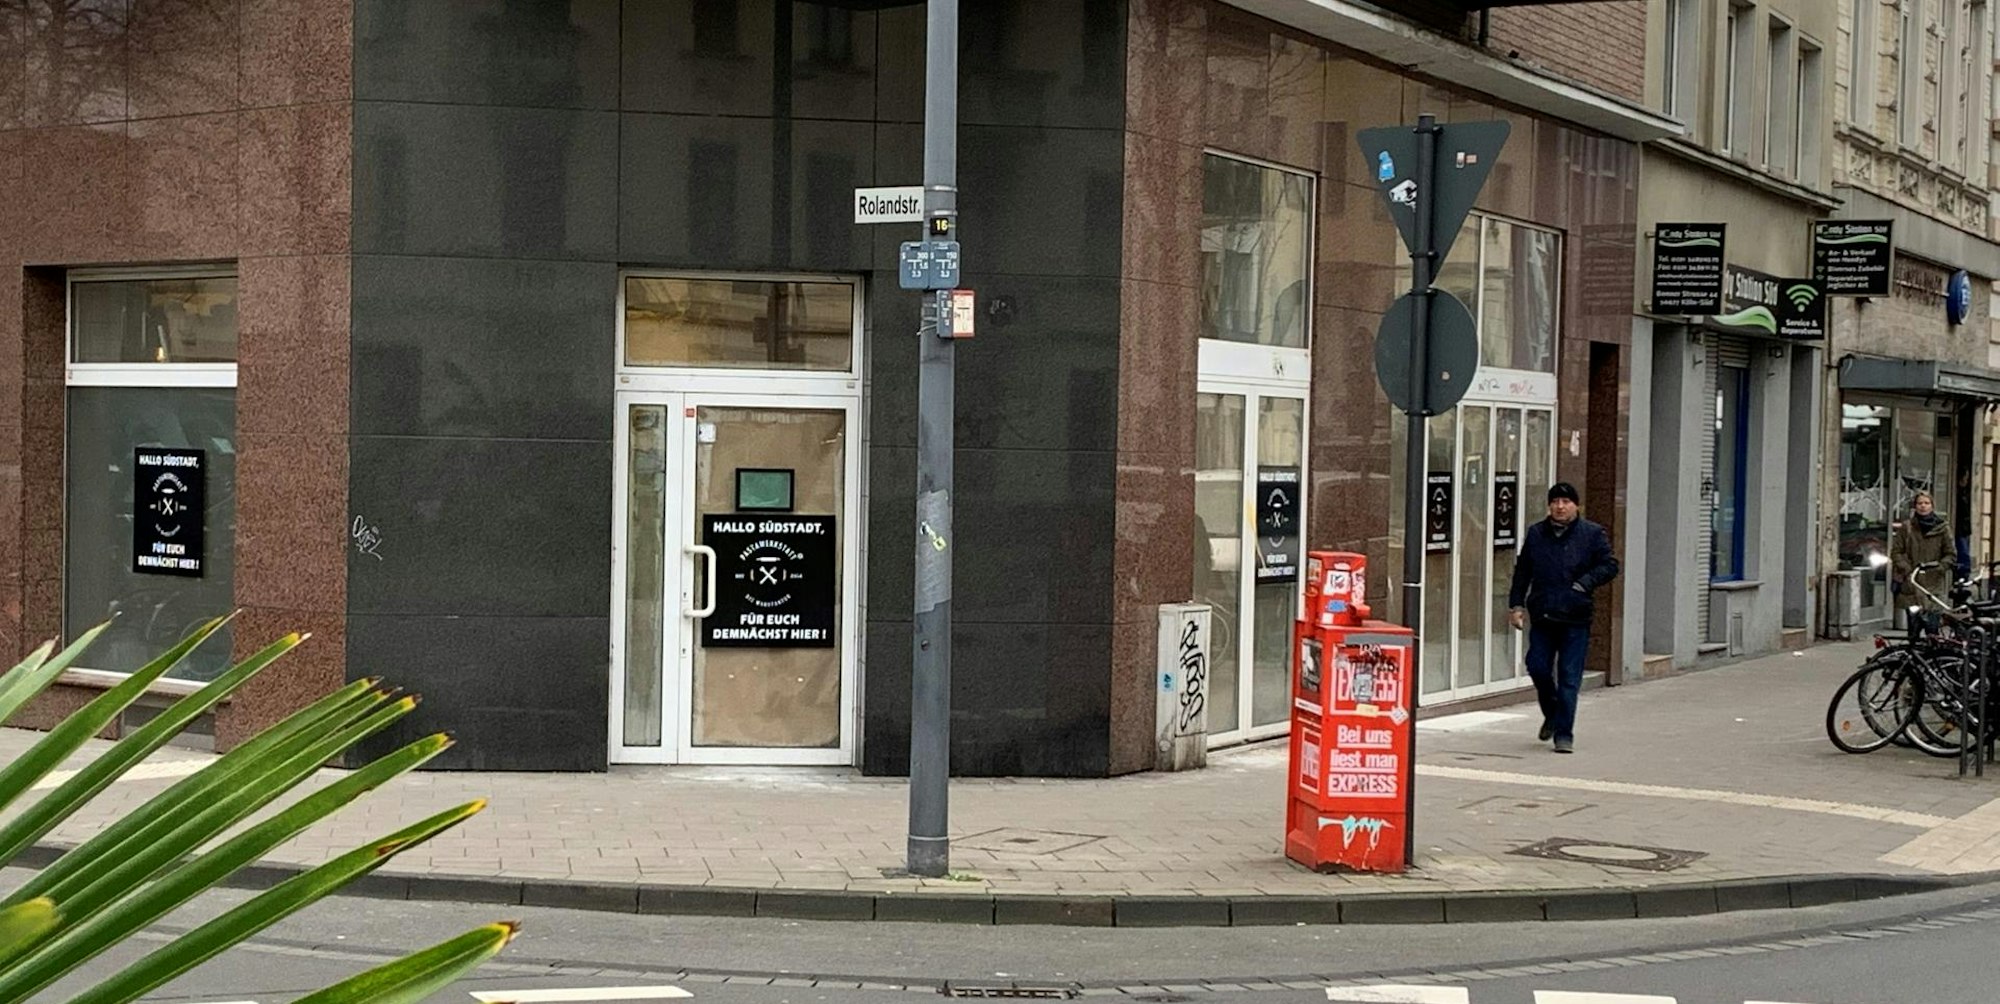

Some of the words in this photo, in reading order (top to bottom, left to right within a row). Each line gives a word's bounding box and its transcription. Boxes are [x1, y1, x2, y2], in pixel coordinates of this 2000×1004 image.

[859, 195, 921, 216] Rolandstr.
[936, 219, 948, 231] 16
[1845, 224, 1873, 234] Station
[1736, 272, 1763, 302] Station
[1764, 280, 1778, 306] Süd
[1785, 318, 1810, 327] Service
[1811, 319, 1818, 327] &
[1781, 327, 1822, 335] Reparaturen
[139, 455, 162, 466] HALLO
[713, 522, 755, 534] HALLO
[759, 520, 825, 535] SÜDSTADT,
[166, 543, 186, 555] EUCH
[740, 612, 764, 625] FÜR
[766, 614, 800, 625] EUCH
[712, 626, 788, 639] DEMNÄCHST
[790, 629, 819, 639] HIER
[1337, 725, 1361, 743] Bei
[1364, 729, 1393, 744] uns
[1330, 749, 1361, 768] liest
[1365, 754, 1398, 769] man
[1328, 774, 1397, 793] EXPRESS
